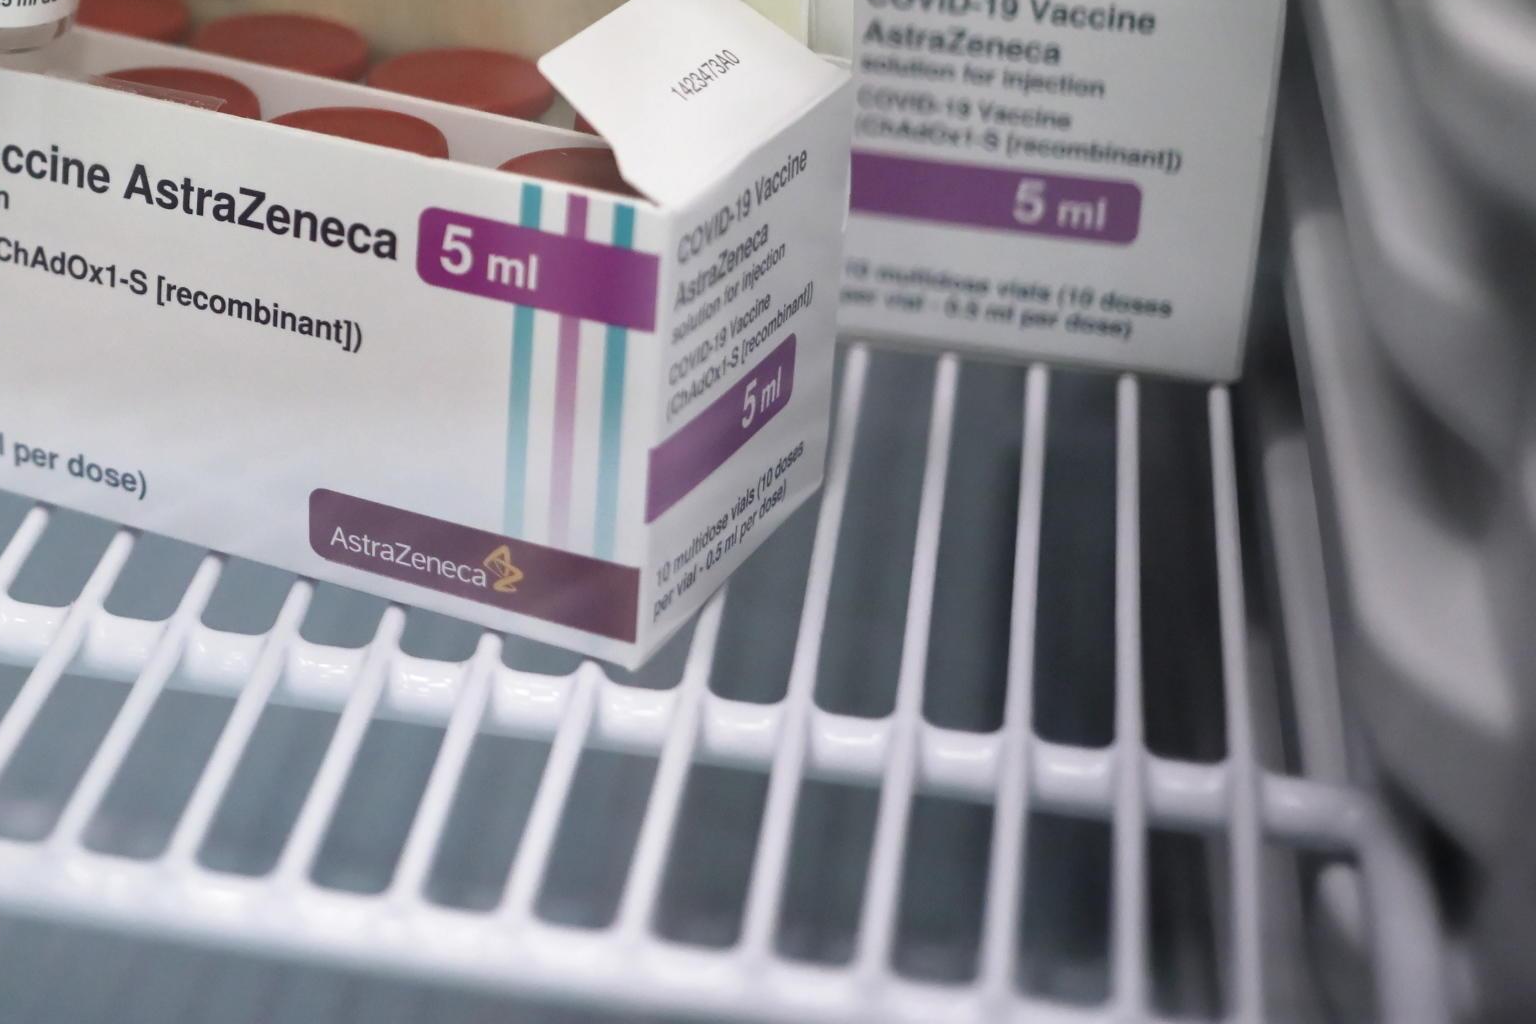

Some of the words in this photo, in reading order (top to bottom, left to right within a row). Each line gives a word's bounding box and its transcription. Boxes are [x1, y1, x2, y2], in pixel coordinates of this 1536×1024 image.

[671, 49, 740, 101] 1423473A0
[863, 18, 1061, 67] AstraZeneca
[963, 64, 994, 86] for
[1002, 69, 1106, 100] injection
[977, 99, 1072, 130] Vaccine
[124, 164, 398, 261] AstraZeneca
[677, 189, 751, 265] COVID-19
[755, 150, 807, 205] Vaccine
[1013, 179, 1047, 224] 5
[1057, 196, 1107, 232] ml
[440, 224, 474, 274] 5
[487, 253, 537, 291] ml
[671, 297, 720, 344] solution
[724, 282, 739, 303] for
[742, 243, 786, 291] injection
[674, 223, 769, 310] AstraZeneca
[156, 276, 363, 353] [recombinant])
[669, 328, 727, 386] COVID-19
[730, 293, 771, 337] Vaccine
[741, 280, 814, 365] [recombinant])
[742, 378, 757, 428] 5
[761, 366, 782, 413] ml
[14, 439, 59, 470] per
[67, 451, 147, 501] dose)
[673, 514, 728, 574] multidose
[731, 487, 755, 521] vials
[757, 467, 773, 500] (10
[775, 441, 804, 479] doses
[330, 526, 486, 587] AstraZeneca
[654, 589, 673, 622] per
[677, 565, 697, 597] vial
[706, 545, 722, 570] 0.5
[724, 526, 737, 553] ml
[739, 512, 756, 544] per
[759, 479, 787, 519] dose)
